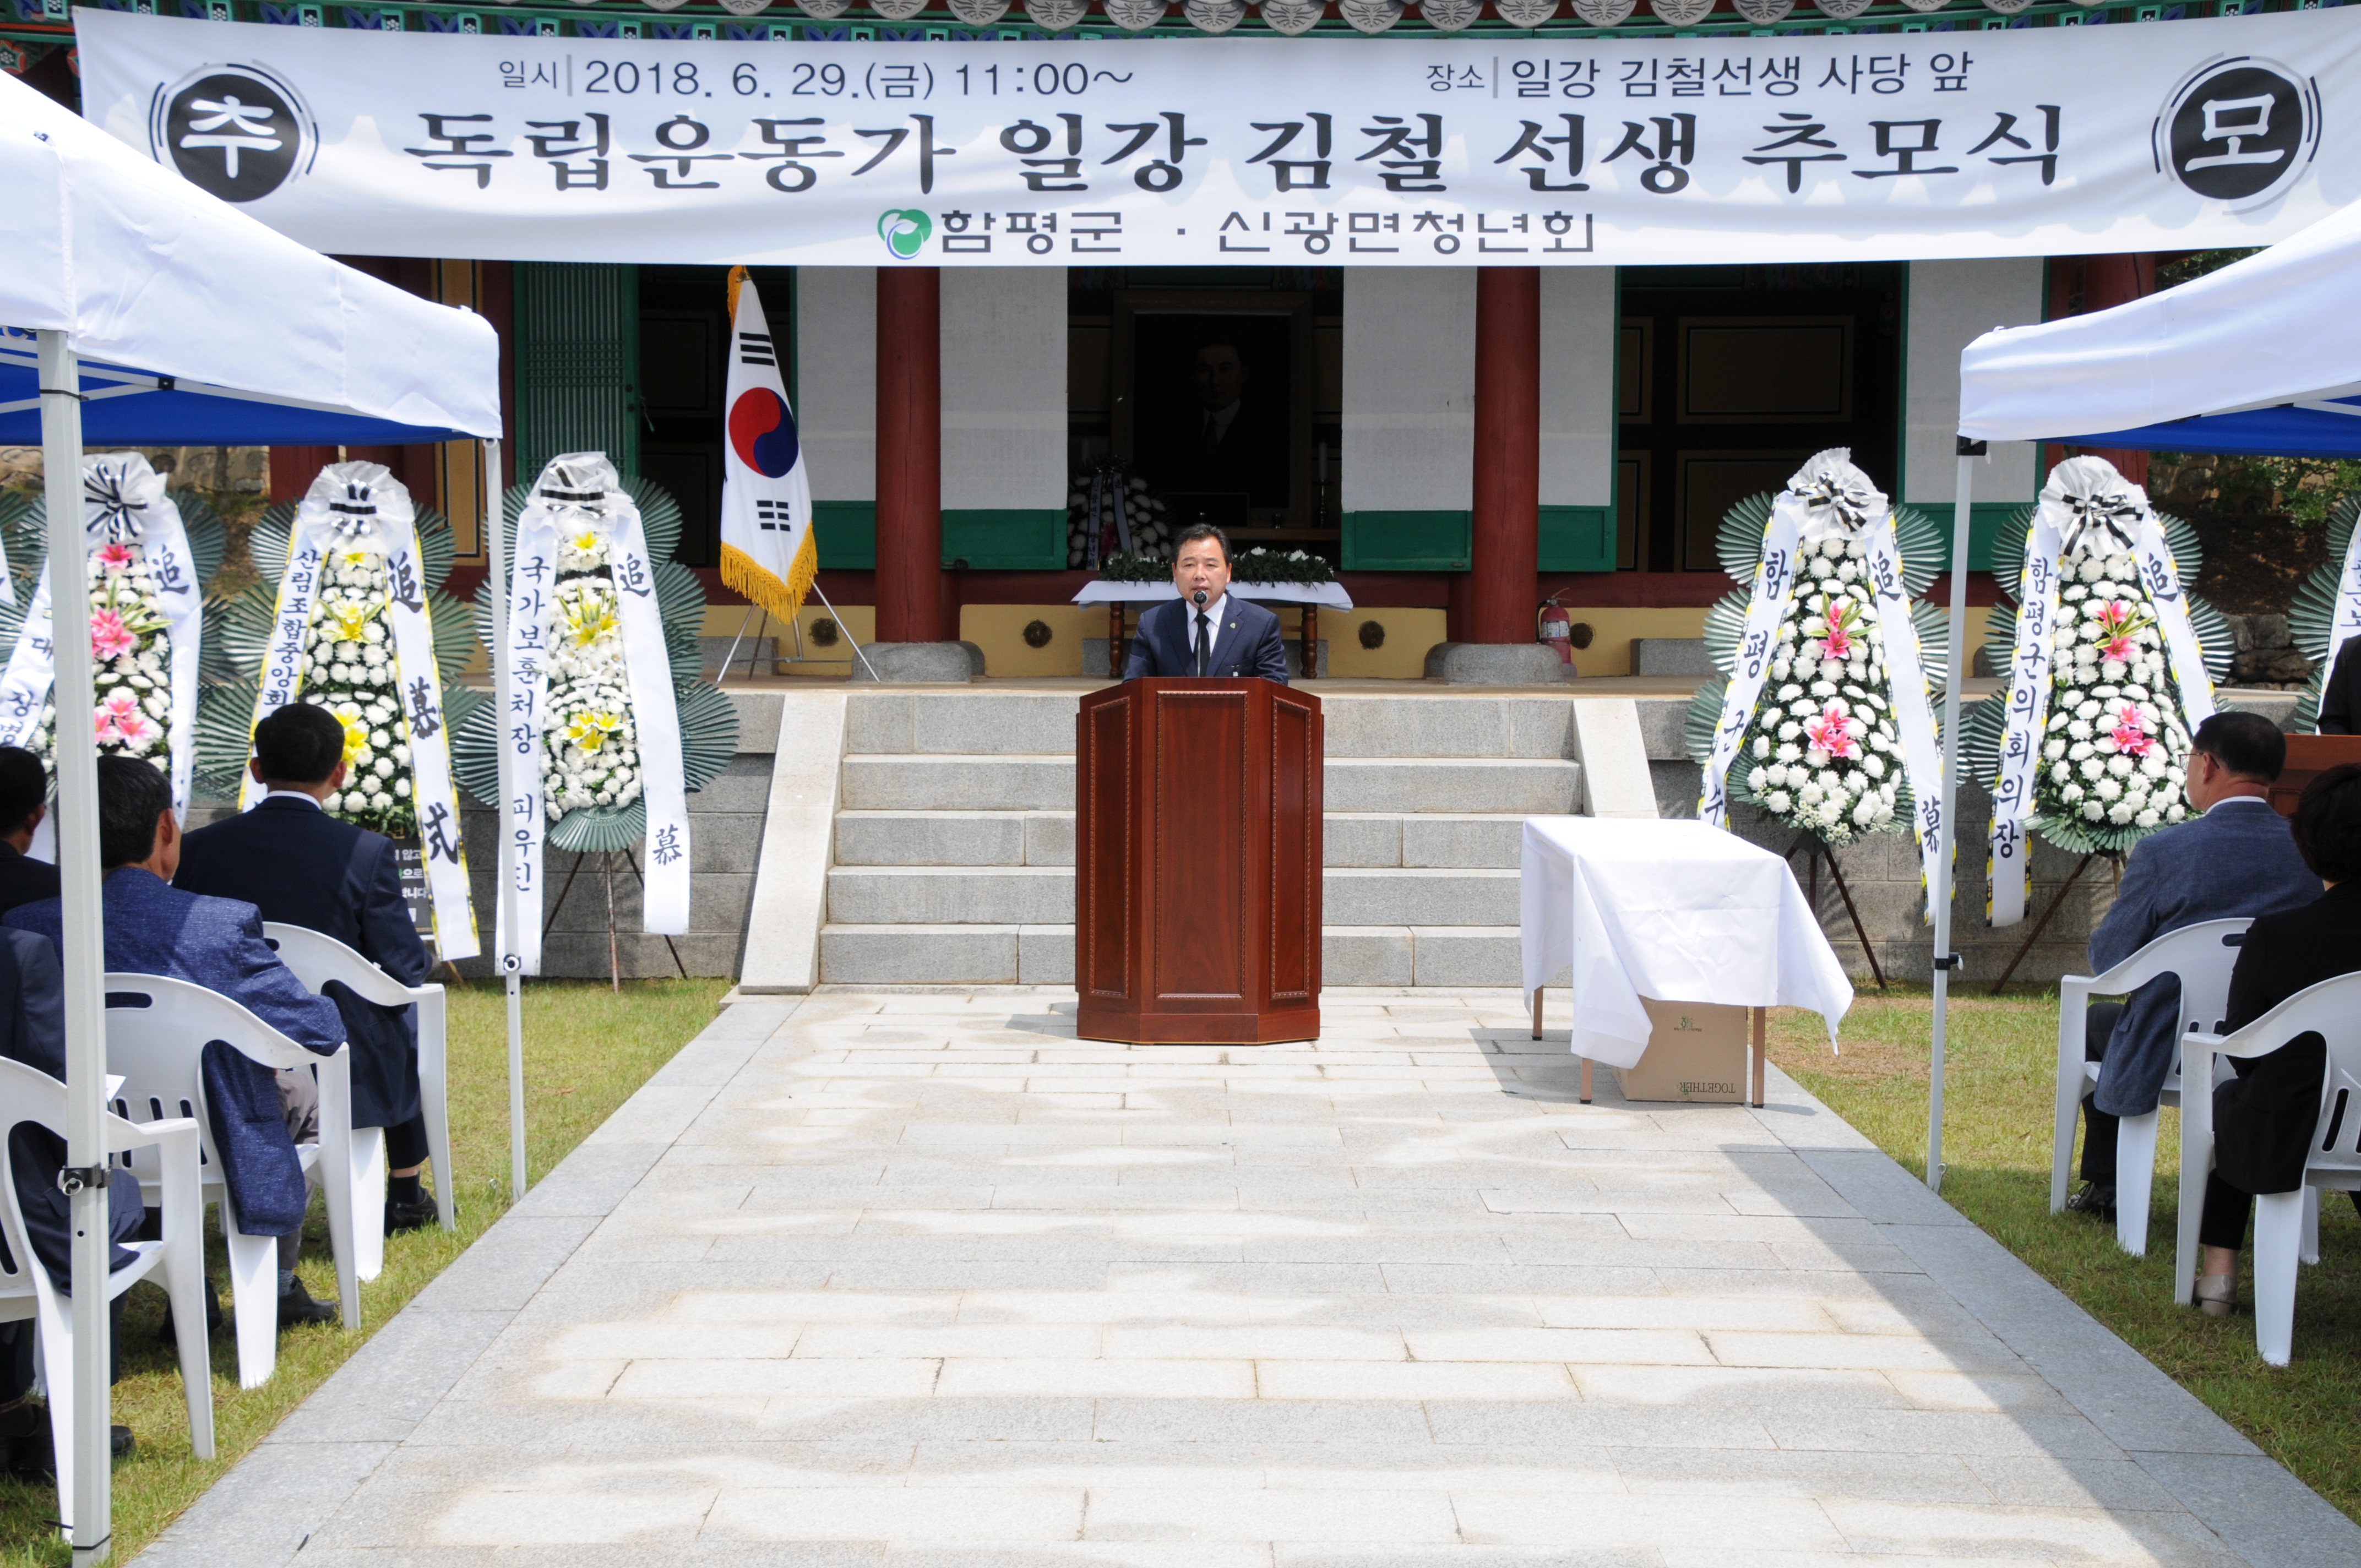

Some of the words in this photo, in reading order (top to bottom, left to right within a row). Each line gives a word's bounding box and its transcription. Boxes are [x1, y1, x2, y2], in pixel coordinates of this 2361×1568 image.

[499, 61, 557, 89] 일시
[586, 61, 711, 97] 2018.
[733, 62, 770, 98] 6.
[792, 62, 934, 100] 29.(금)
[1427, 64, 1485, 91] 장소
[1512, 58, 1601, 99] 일강
[1620, 56, 1800, 97] 김철선생
[1818, 53, 1911, 94] 사당
[1930, 51, 1974, 92] 앞
[180, 94, 285, 180] 추
[404, 112, 956, 195] 독립운동가
[999, 111, 1208, 193] 일강
[1245, 112, 1447, 193] 김철
[1493, 112, 1696, 194] 선생
[1742, 105, 2061, 194] 추모식
[2183, 91, 2286, 173] 모
[941, 210, 1122, 255] 함평군
[1219, 211, 1593, 255] 신광면청년회
[263, 548, 322, 706] 산림조합중앙회
[510, 556, 551, 754] 국가보훈처장
[1994, 556, 2054, 859] 함평군의회의장
[1679, 1082, 1736, 1093] TOGETHER
